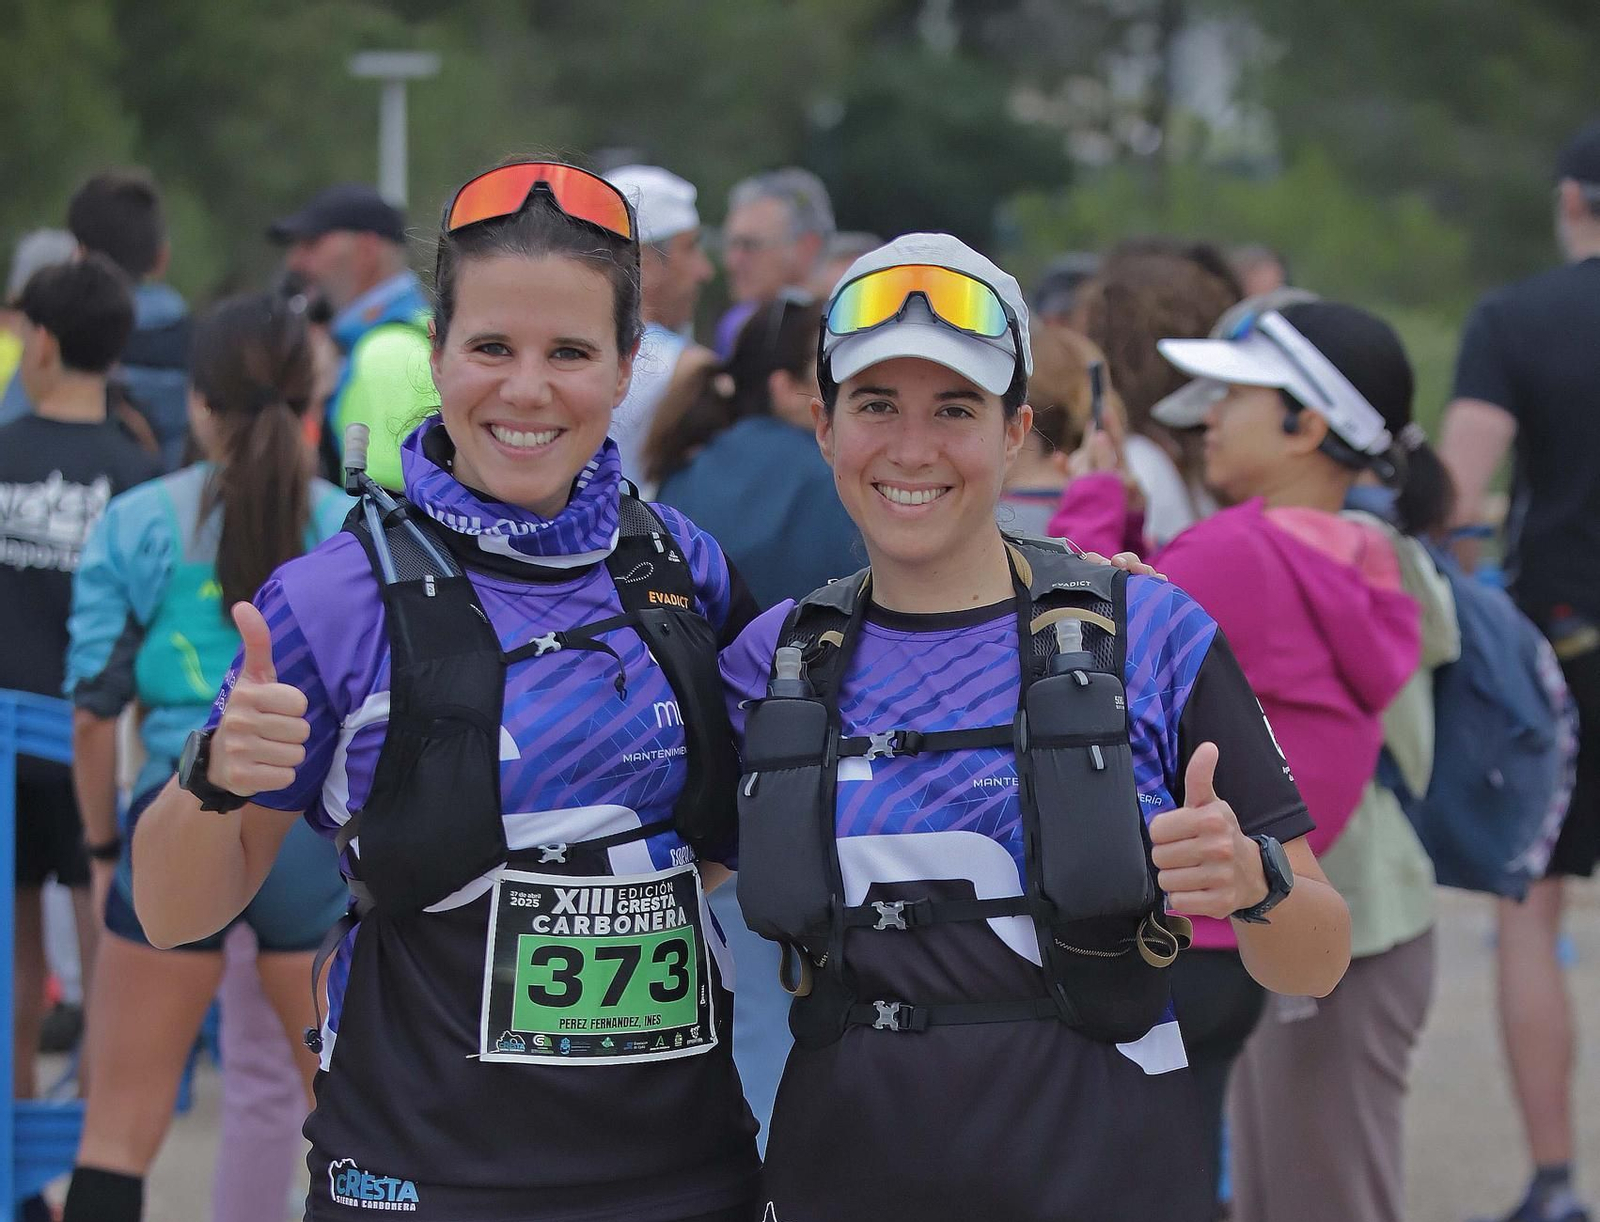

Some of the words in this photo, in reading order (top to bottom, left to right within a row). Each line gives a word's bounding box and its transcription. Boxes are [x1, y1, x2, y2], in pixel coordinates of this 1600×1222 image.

[648, 590, 689, 609] EVADICT
[510, 897, 540, 908] 2025
[551, 887, 614, 915] XIII
[618, 881, 674, 900] EDICIÓN
[617, 894, 677, 914] CRESTA
[532, 907, 687, 935] CARBONERA
[528, 938, 690, 1009] 373
[559, 1018, 587, 1030] PEREZ
[590, 1016, 642, 1029] FERNANDEZ,
[644, 1014, 662, 1026] INES
[336, 1168, 420, 1203] CRESTA
[336, 1195, 359, 1207] SIERRA
[362, 1200, 417, 1212] CARBONERA
